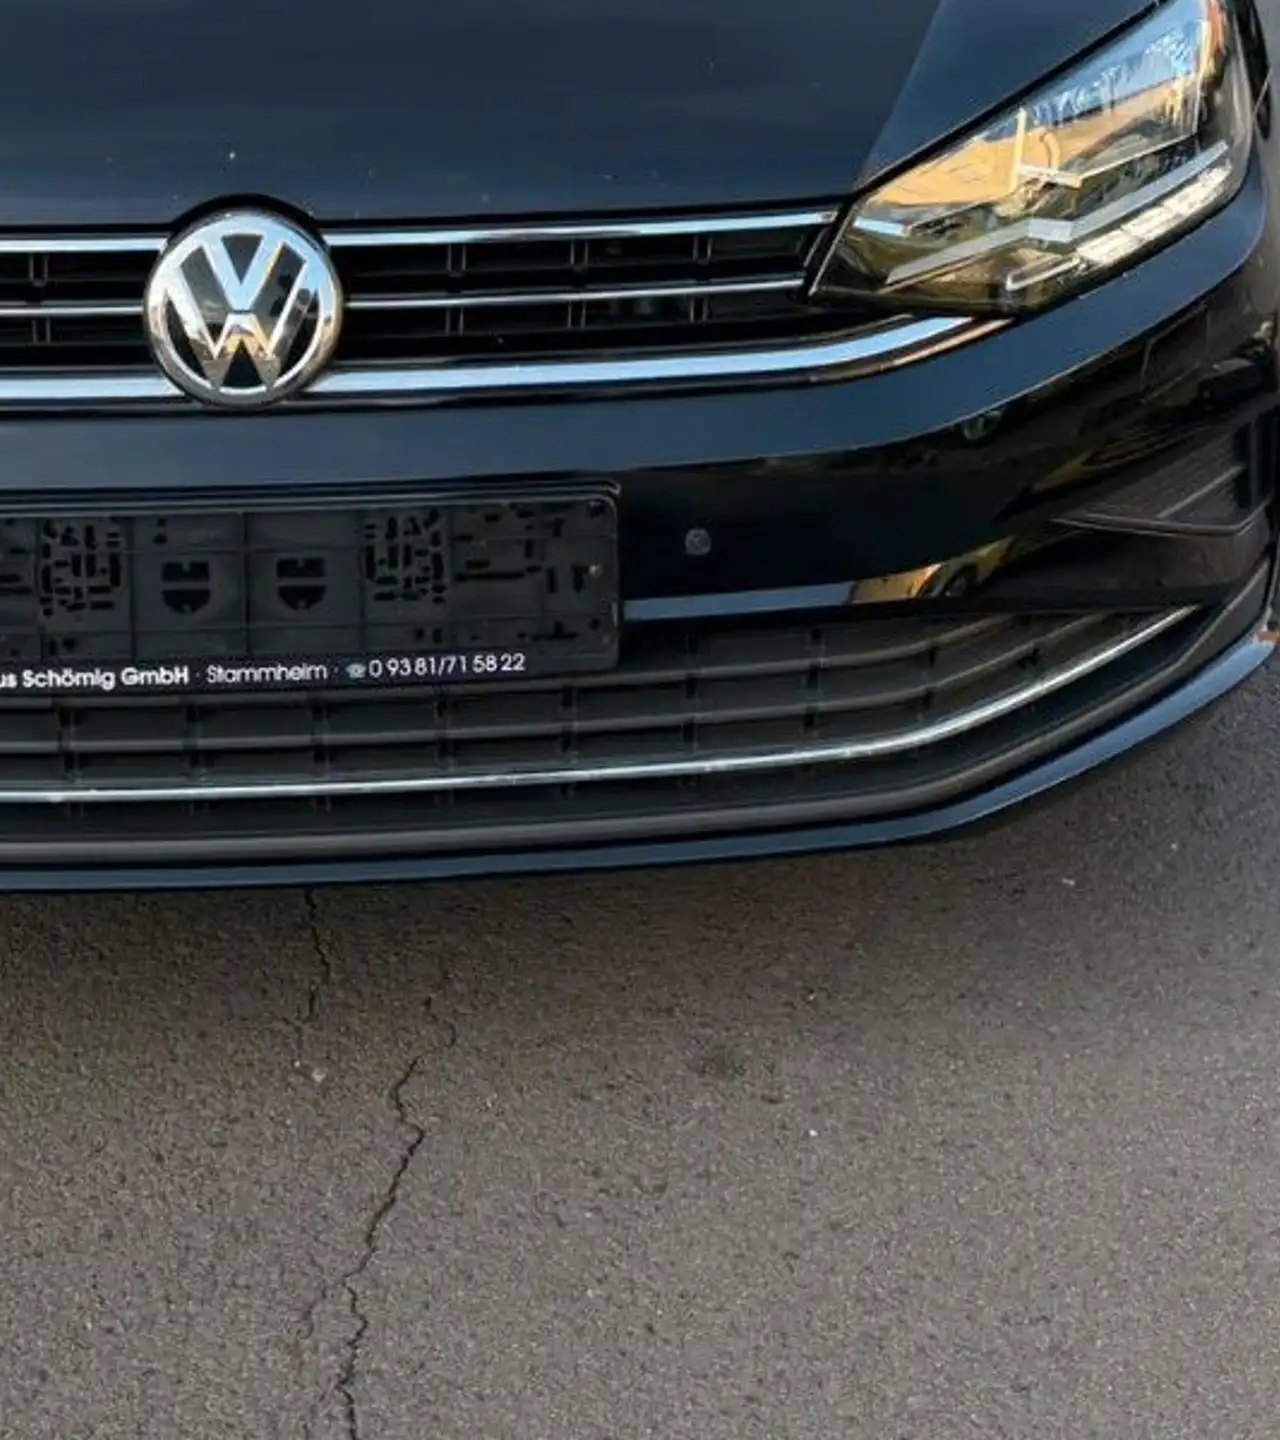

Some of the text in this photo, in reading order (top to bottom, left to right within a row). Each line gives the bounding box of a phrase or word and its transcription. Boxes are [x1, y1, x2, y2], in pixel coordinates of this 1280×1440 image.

[22, 667, 116, 691] Schömig
[121, 664, 190, 687] GmbH
[207, 661, 328, 684] Stammheim
